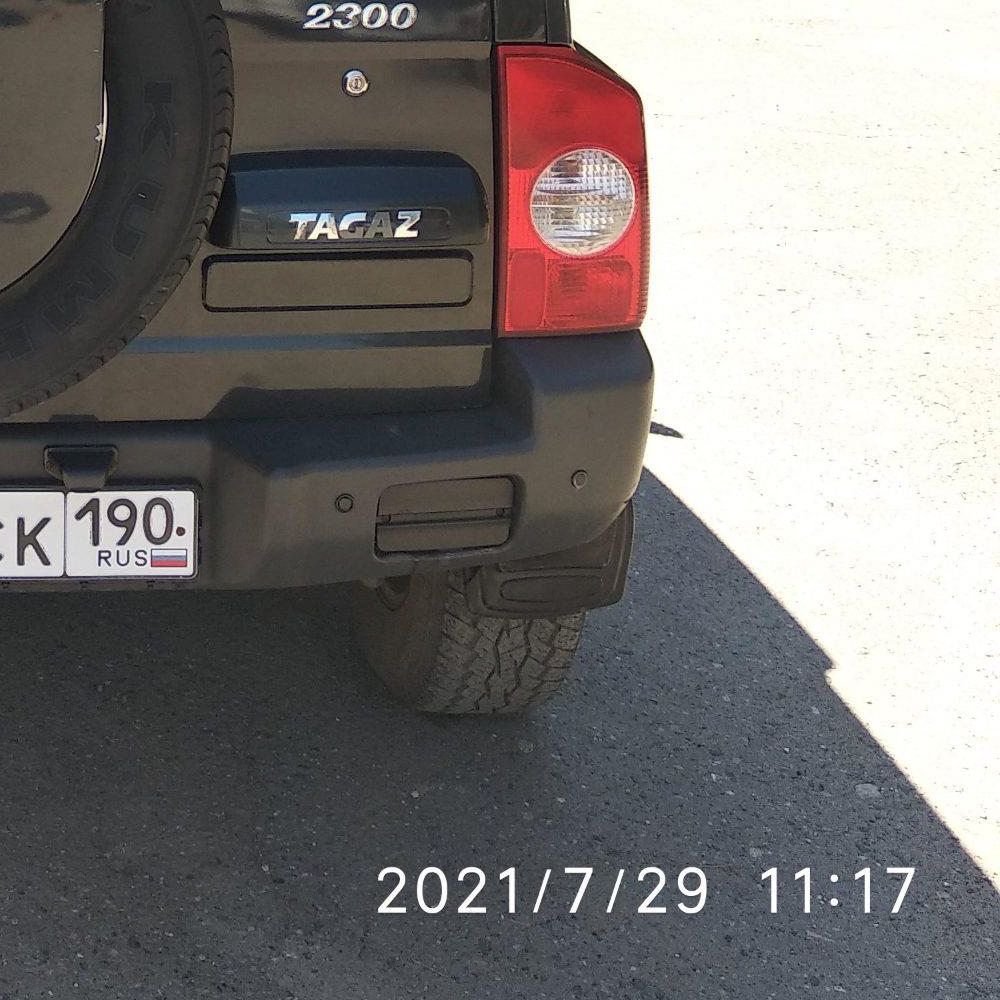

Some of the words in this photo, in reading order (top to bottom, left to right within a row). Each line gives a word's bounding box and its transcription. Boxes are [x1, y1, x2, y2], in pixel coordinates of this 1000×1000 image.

[302, 2, 419, 30] 2300
[288, 210, 422, 240] TAGAZ
[74, 496, 175, 547] 190
[97, 549, 148, 567] RUS
